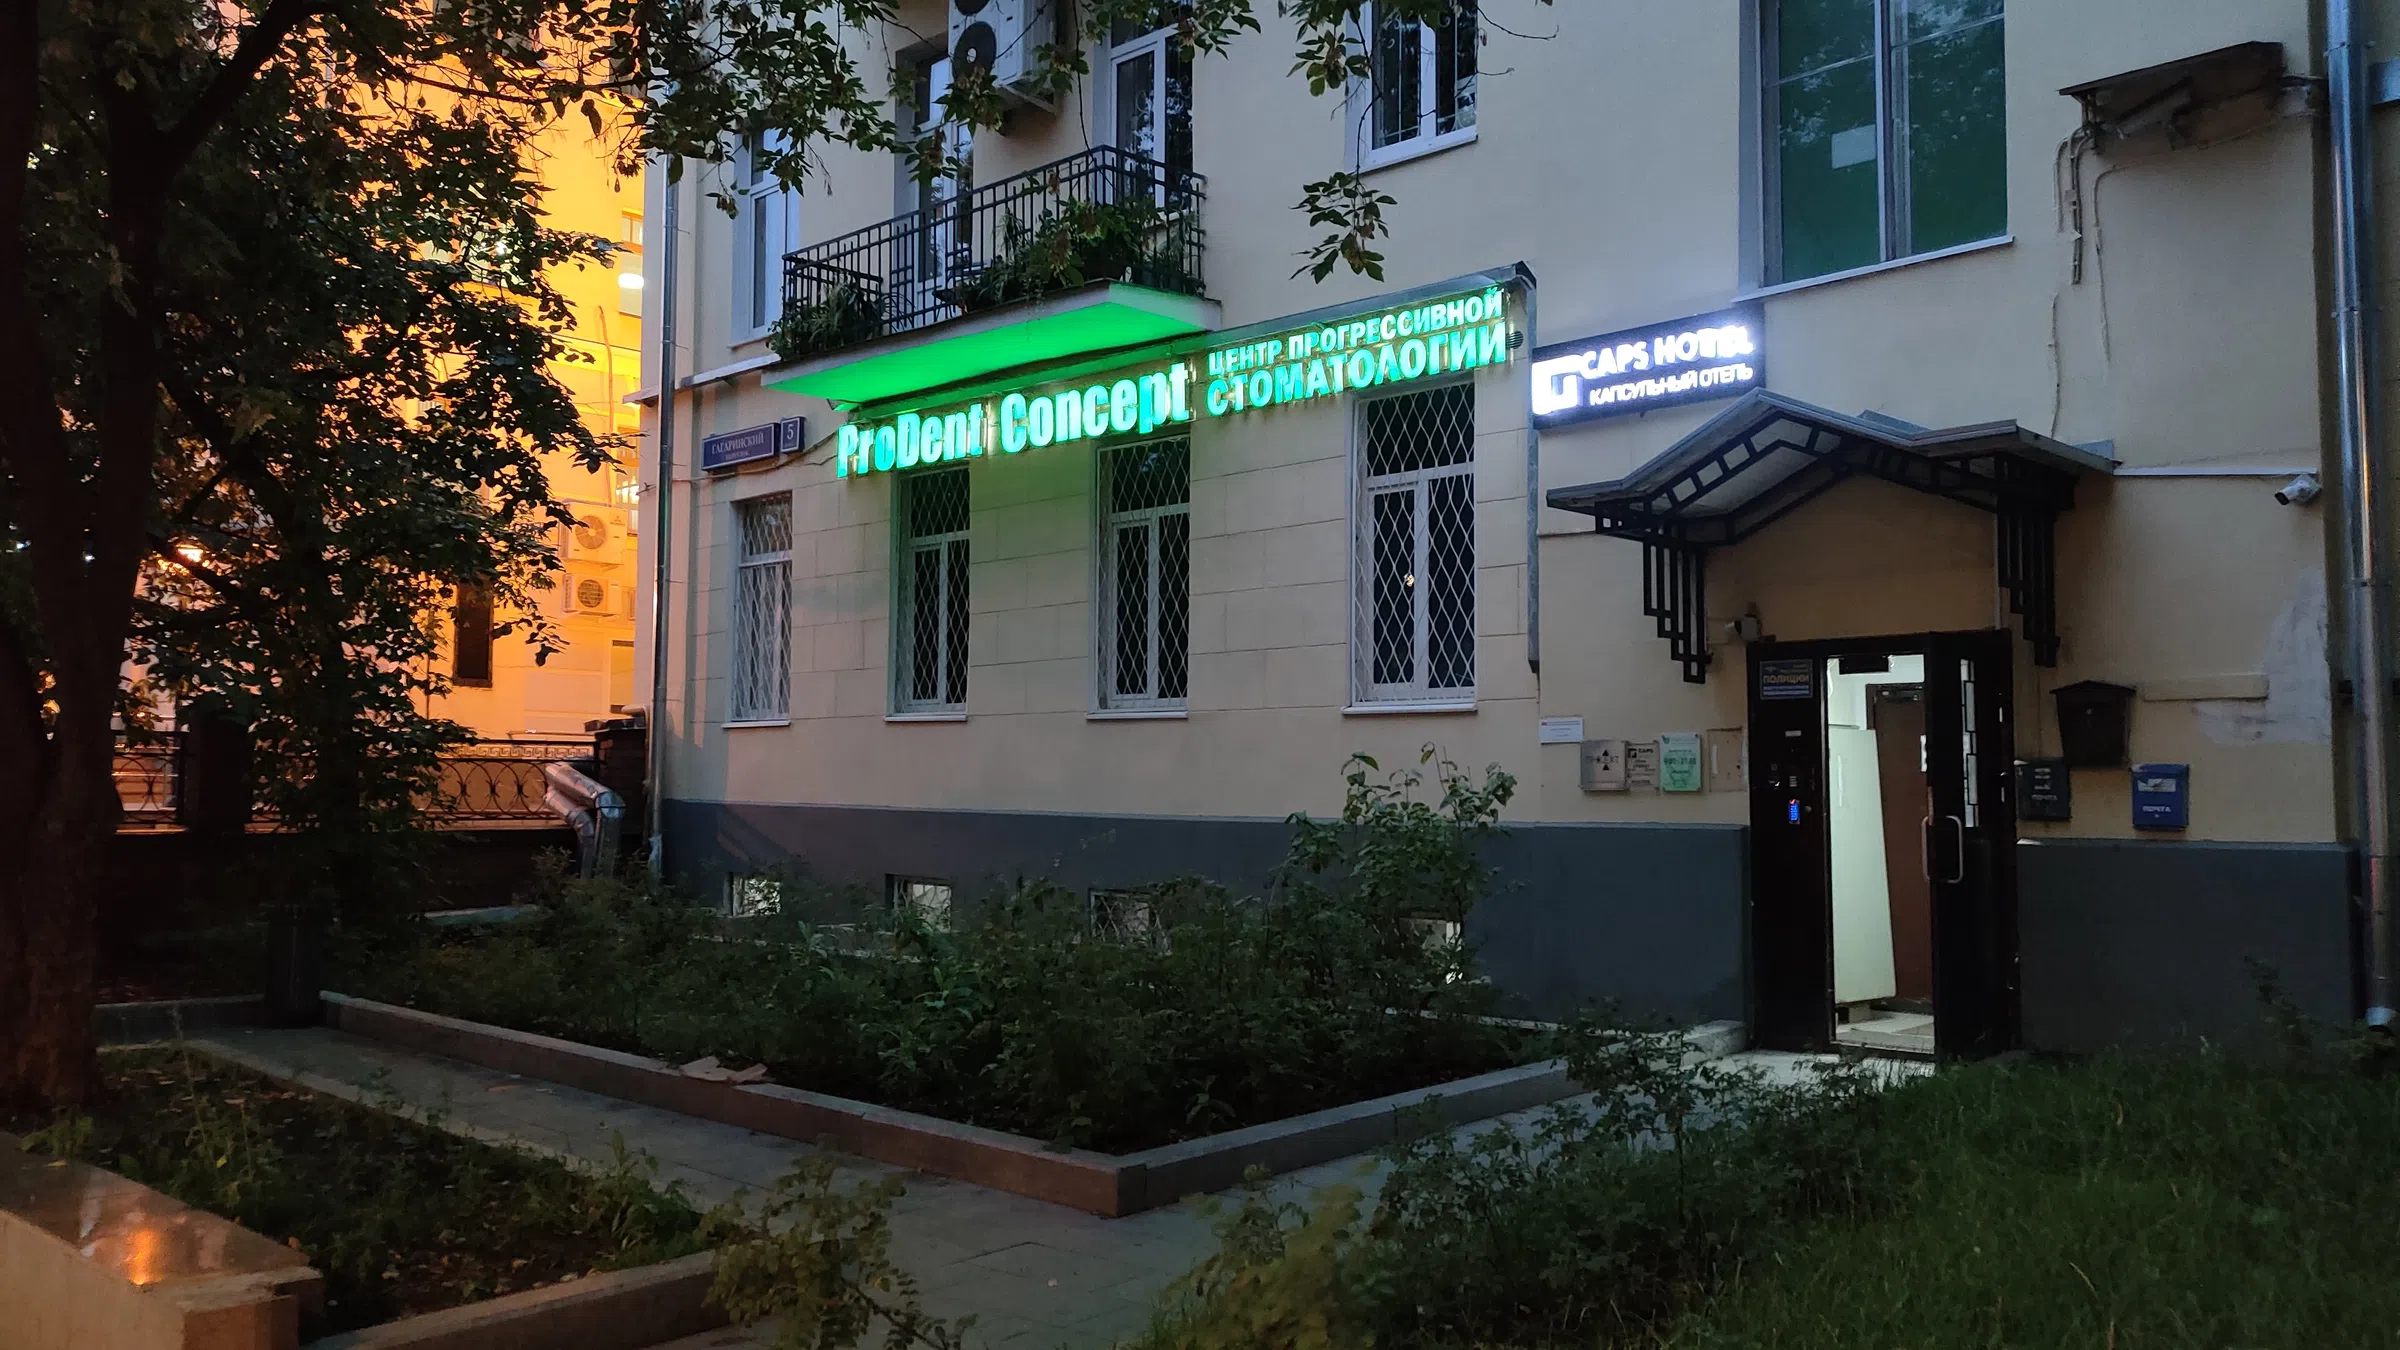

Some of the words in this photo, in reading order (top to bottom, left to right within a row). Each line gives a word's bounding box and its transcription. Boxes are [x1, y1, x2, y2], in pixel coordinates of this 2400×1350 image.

[1208, 339, 1282, 377] ЦЕНТР
[1288, 287, 1502, 360] ПРОГРЕССИВНОЙ
[1206, 321, 1506, 417] СТОМАТОЛОГИИ
[1580, 342, 1649, 379] CAPS
[1590, 369, 1698, 406] КАПСУЛЬНЫЙ
[1699, 363, 1754, 387] ОТЕЛЬ
[787, 424, 794, 440] 5
[837, 403, 985, 478] ProDent
[1000, 361, 1190, 453] Concept
[712, 432, 764, 454] ГАГАРИНСКИЙ
[1763, 674, 1810, 684] ПОЛИЦИИ
